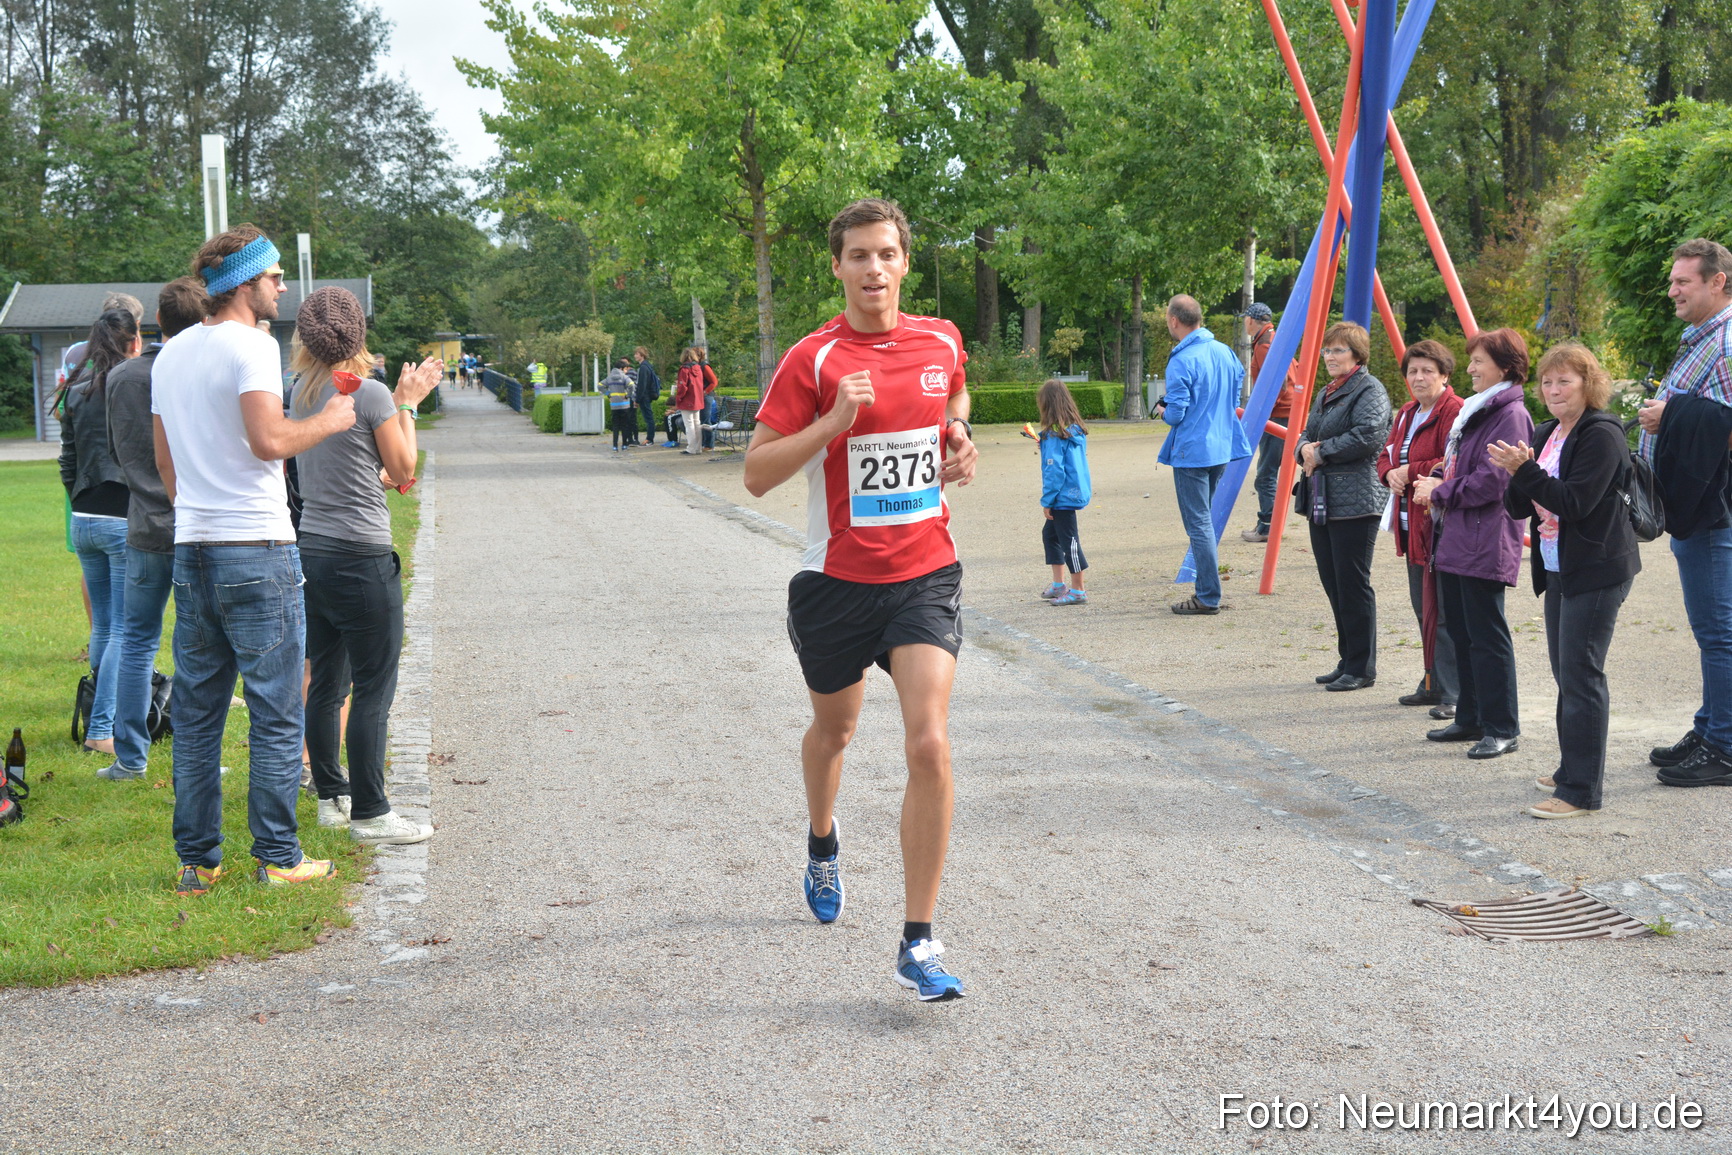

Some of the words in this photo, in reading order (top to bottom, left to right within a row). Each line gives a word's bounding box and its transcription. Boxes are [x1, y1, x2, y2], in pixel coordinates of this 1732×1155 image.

[850, 443, 884, 452] PARTL
[887, 438, 928, 450] Neumarkt
[860, 450, 936, 490] 2373
[876, 497, 923, 512] Thomas
